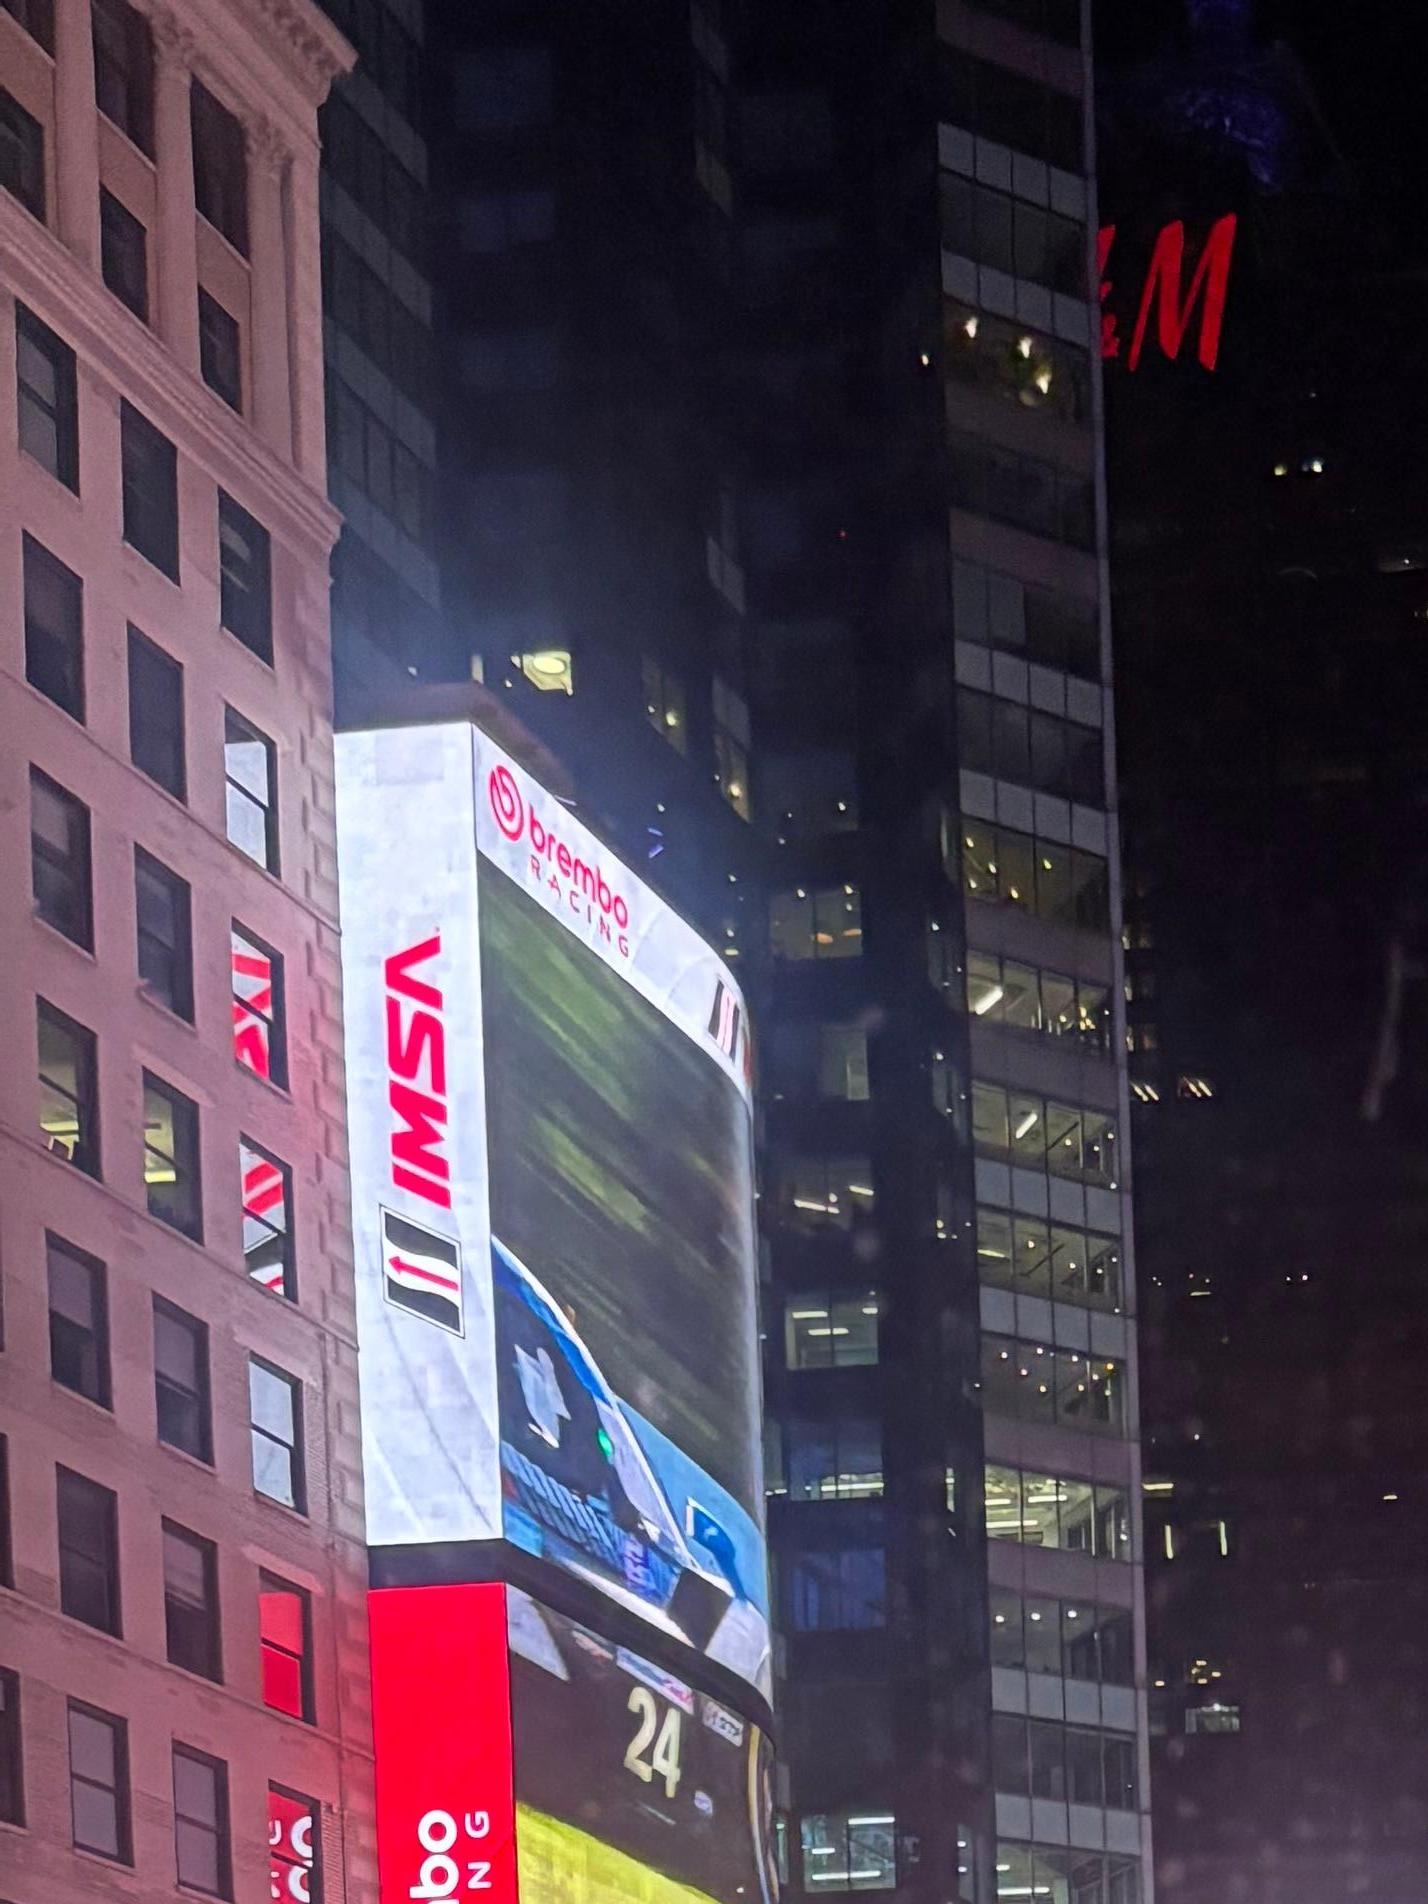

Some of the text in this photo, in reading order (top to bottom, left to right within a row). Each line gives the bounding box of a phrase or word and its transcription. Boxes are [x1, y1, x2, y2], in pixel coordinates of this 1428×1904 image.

[529, 806, 629, 929] brembo
[530, 857, 630, 959] RACING
[385, 934, 452, 1209] IMSA
[624, 1686, 681, 1798] 24
